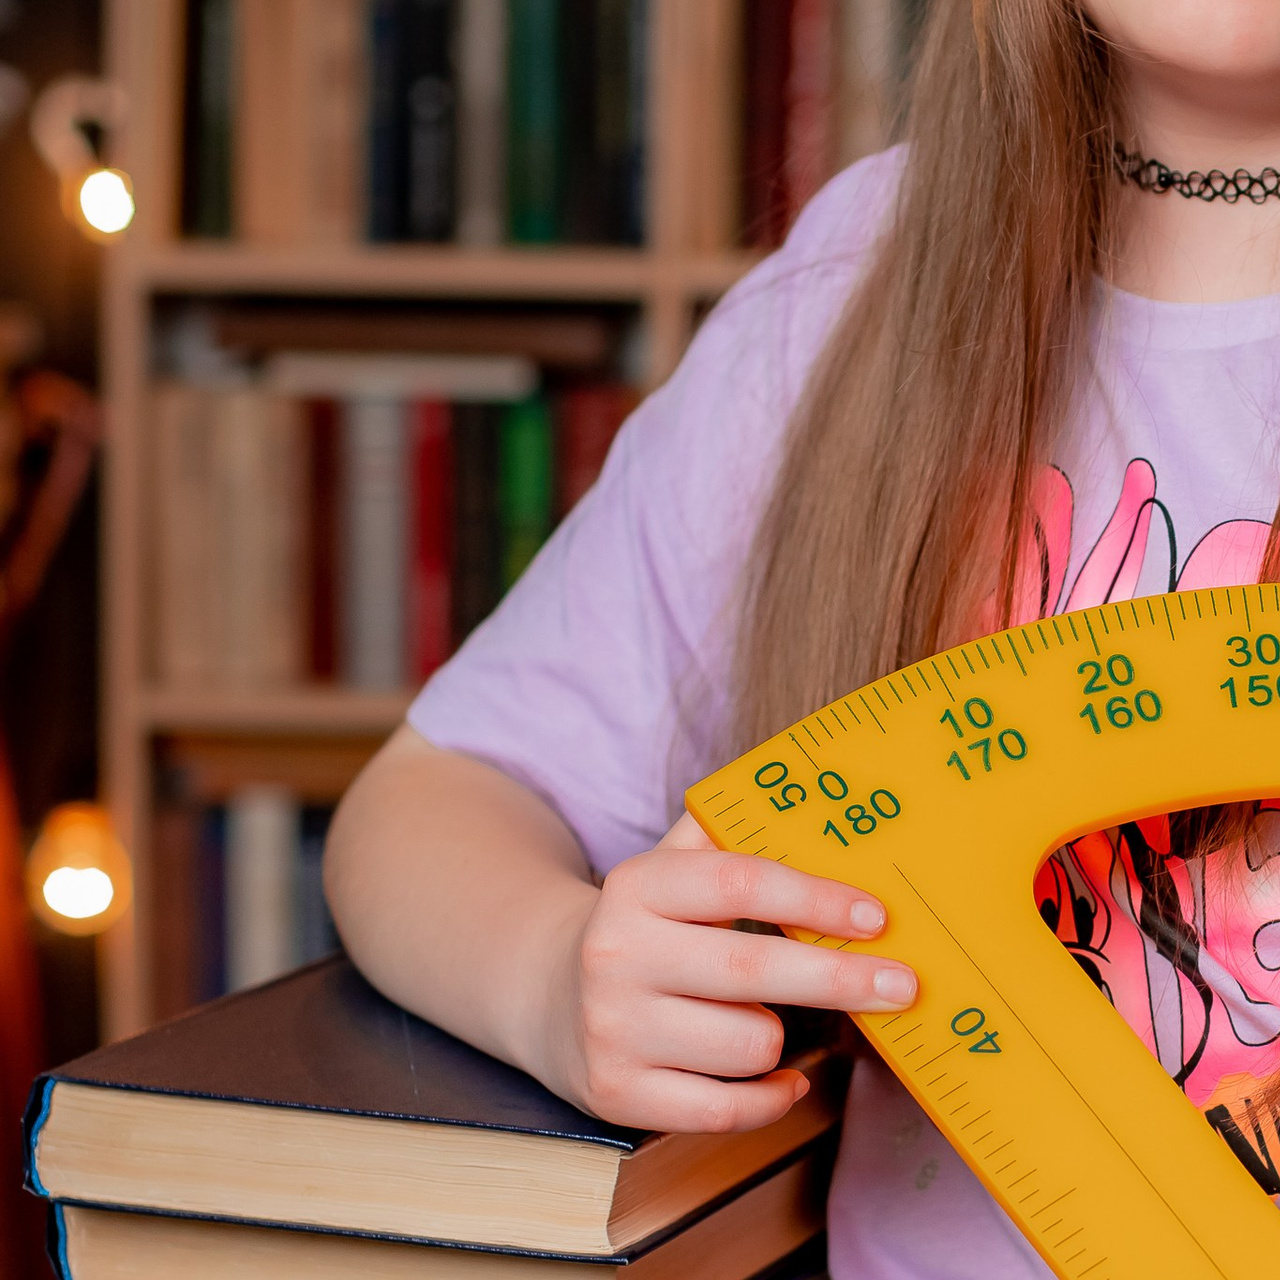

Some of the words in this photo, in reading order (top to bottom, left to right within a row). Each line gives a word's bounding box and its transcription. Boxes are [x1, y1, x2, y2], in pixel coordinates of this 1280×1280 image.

[1226, 634, 1280, 667] 30
[1077, 654, 1135, 695] 20
[940, 697, 994, 738] 10
[1079, 689, 1162, 734] 160
[947, 728, 1028, 781] 170
[754, 762, 807, 812] 50
[818, 771, 848, 800] 0
[823, 787, 901, 847] 180
[951, 1008, 1002, 1053] 40
